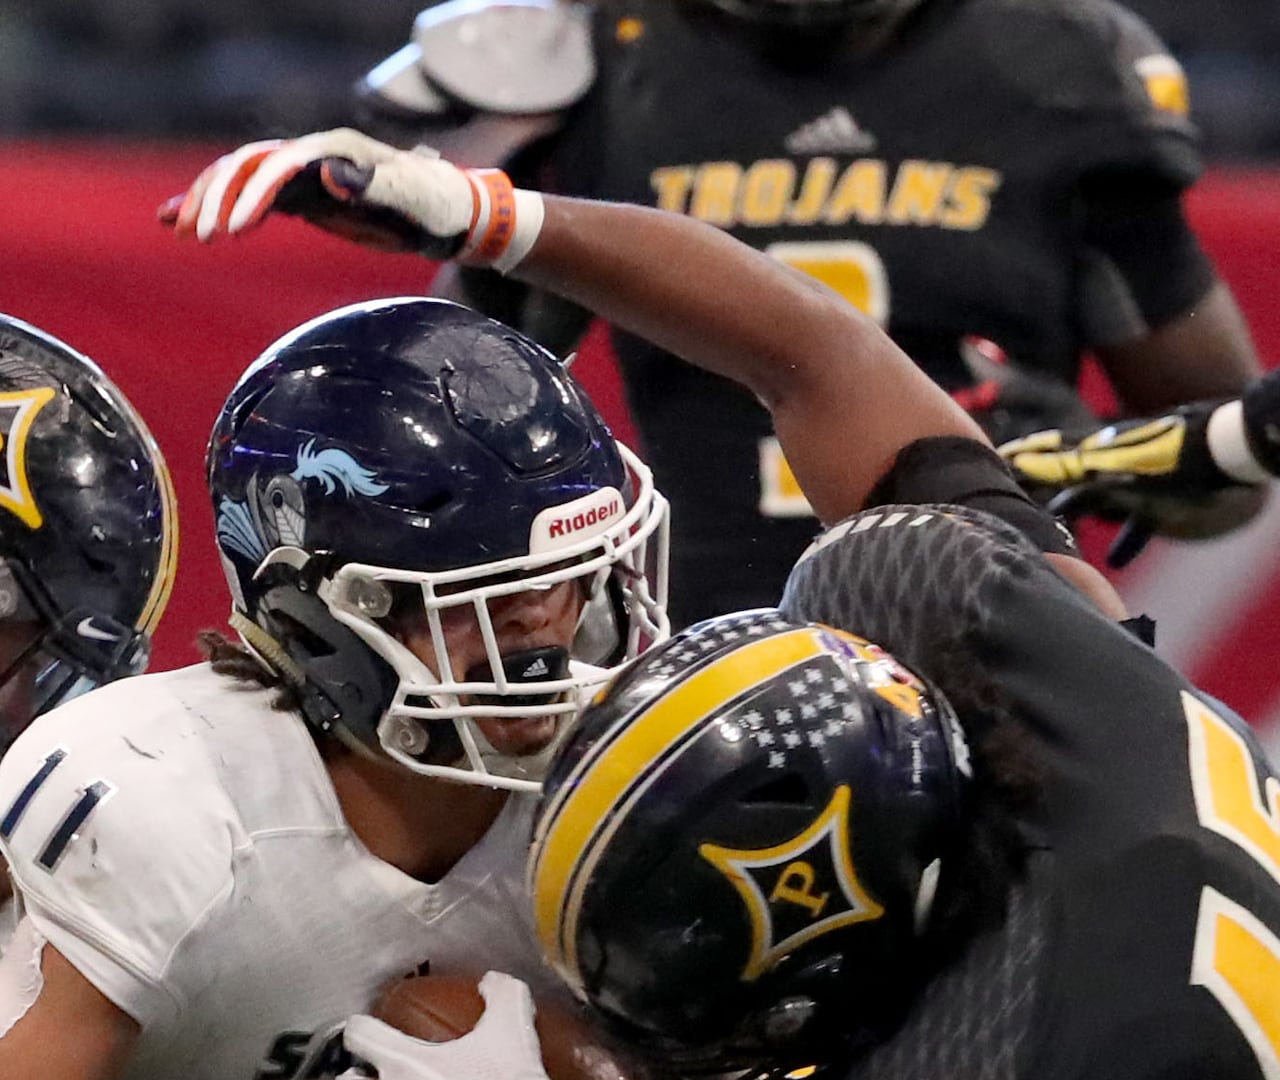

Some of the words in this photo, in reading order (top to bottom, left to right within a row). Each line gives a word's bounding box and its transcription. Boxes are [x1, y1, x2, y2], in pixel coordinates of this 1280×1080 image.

[650, 157, 1002, 230] TROJANS
[549, 500, 619, 538] Riddell
[768, 860, 830, 917] P
